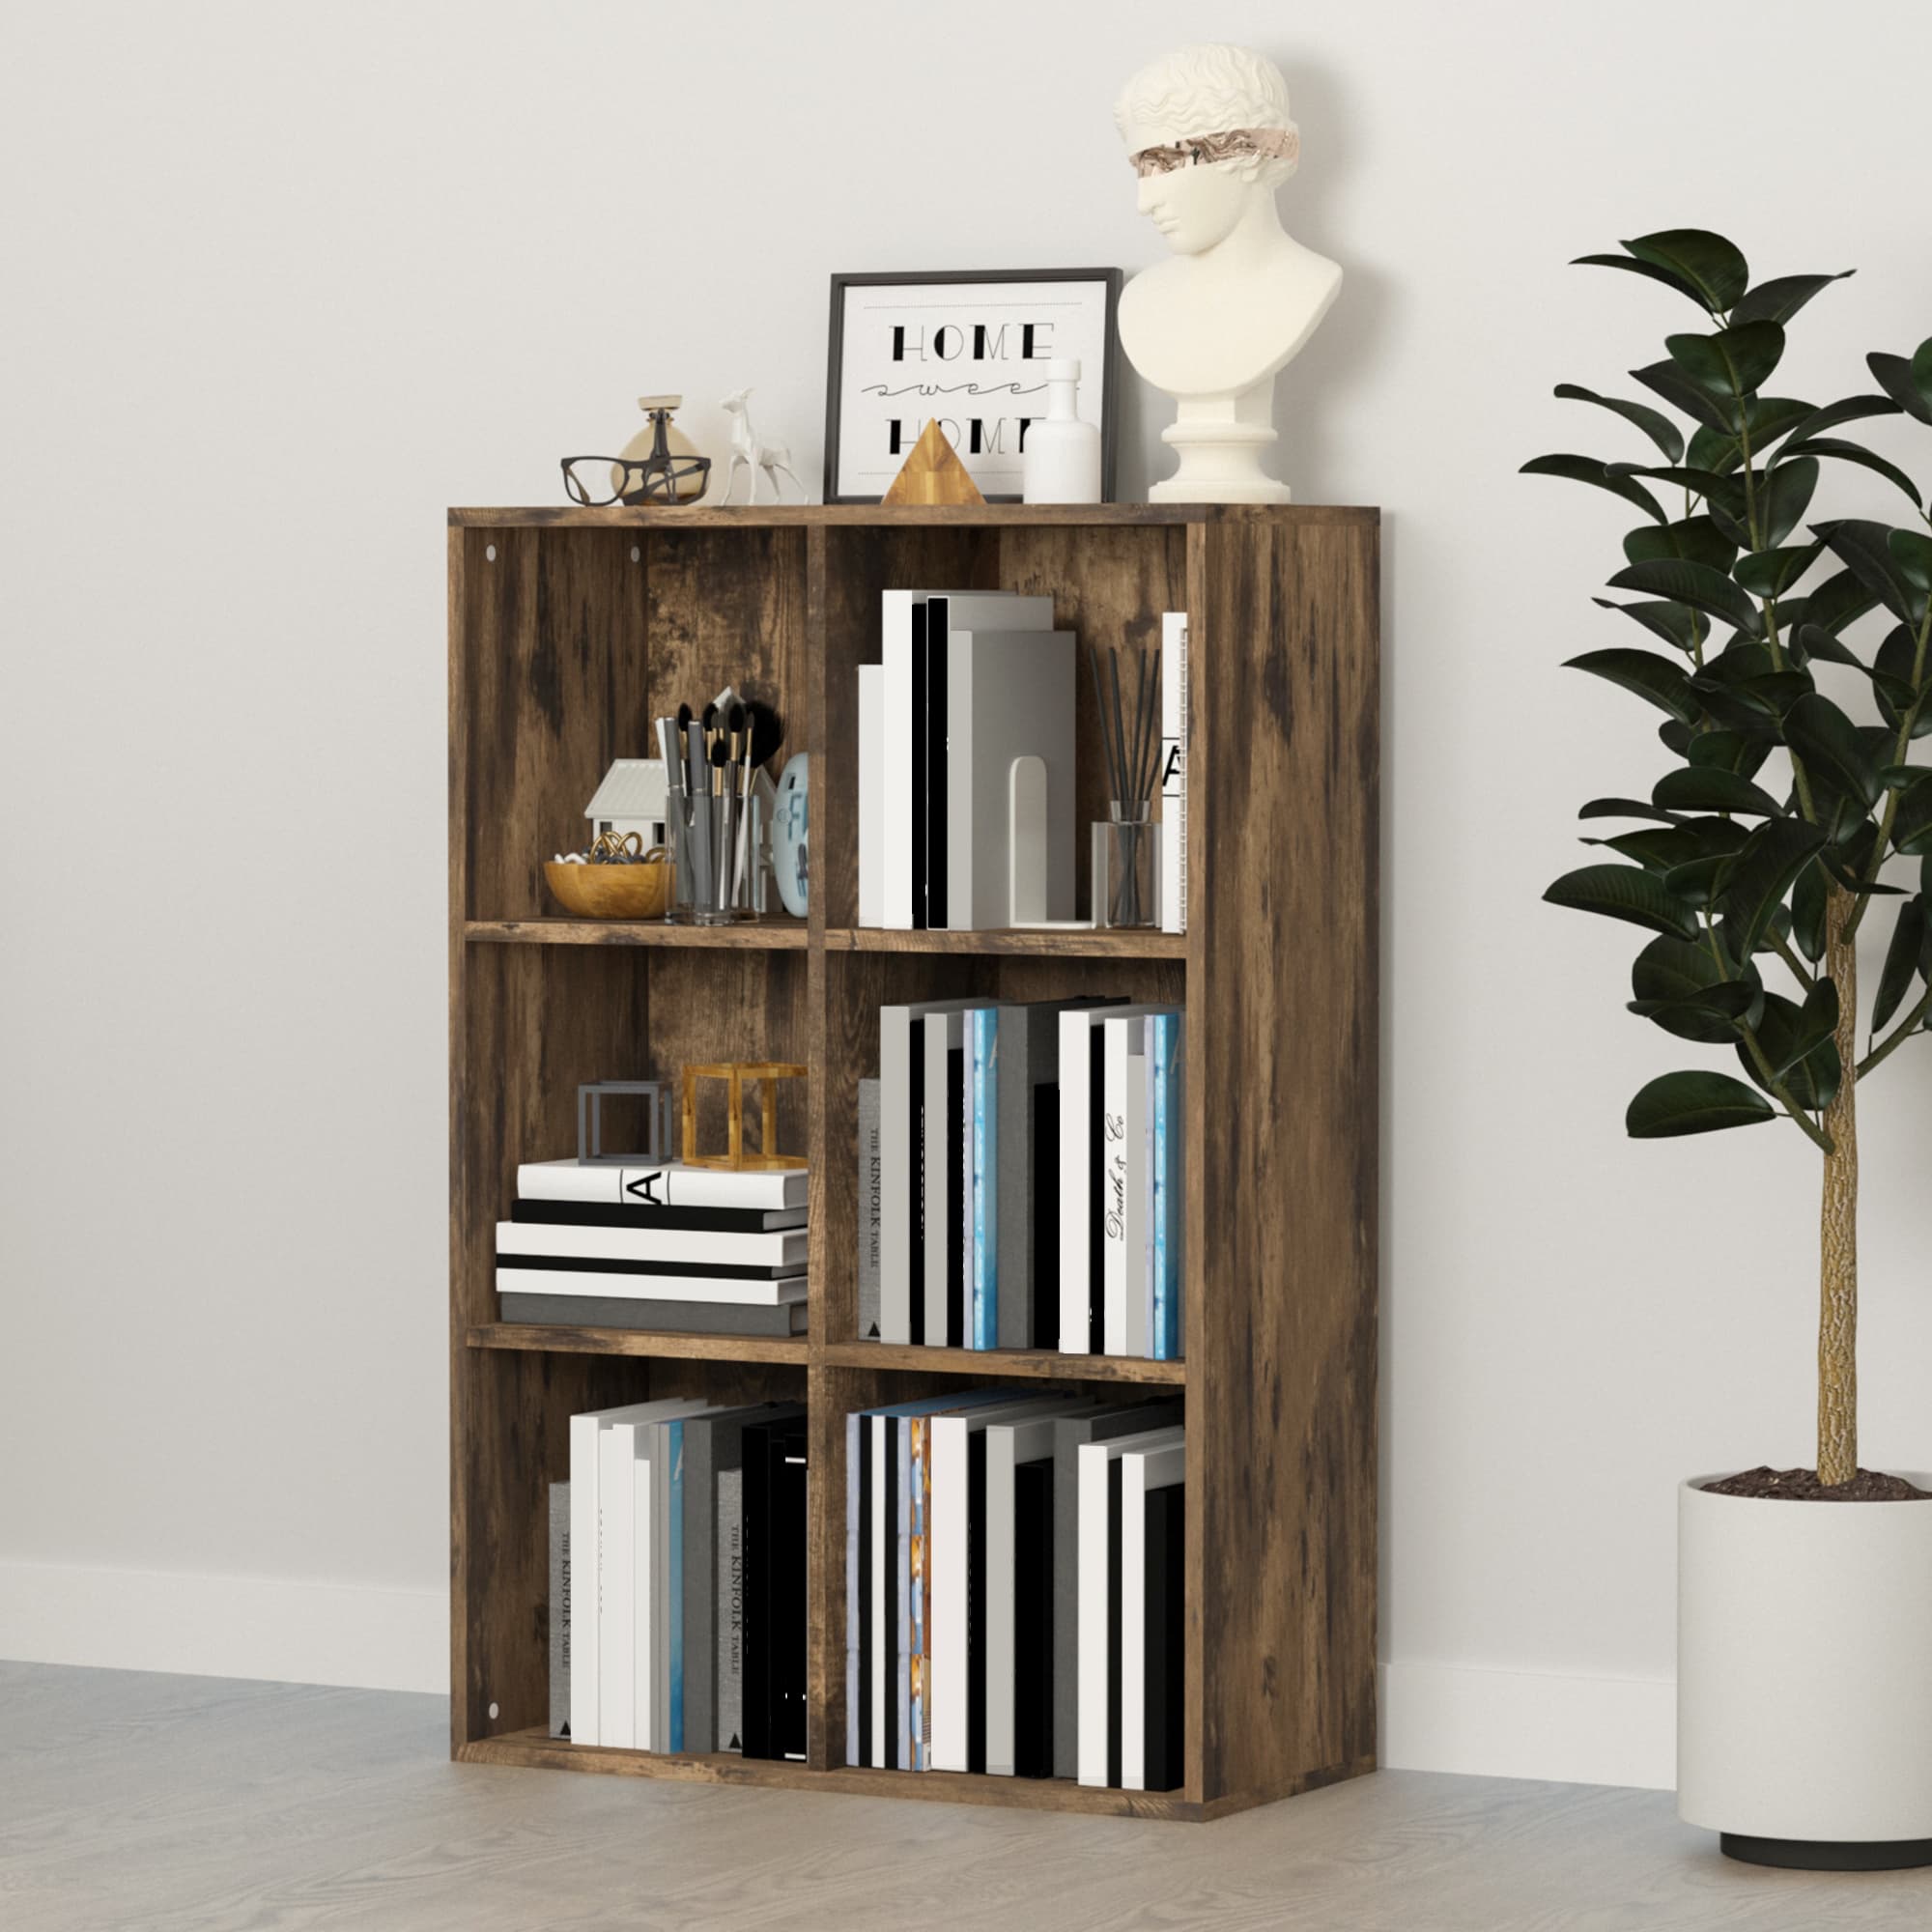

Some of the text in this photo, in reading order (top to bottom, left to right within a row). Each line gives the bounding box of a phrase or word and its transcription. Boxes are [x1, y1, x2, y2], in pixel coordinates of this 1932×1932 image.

[889, 323, 1055, 361] HOME
[861, 383, 1080, 397] swee
[1104, 1113, 1124, 1142] Co
[626, 1171, 663, 1207] A
[870, 1128, 881, 1268] THE KINFOLK TABLE
[1105, 1168, 1123, 1241] Death
[561, 1531, 571, 1668] THE KINFOLK TABLE
[731, 1525, 742, 1674] THE KINFOLK TABLE
